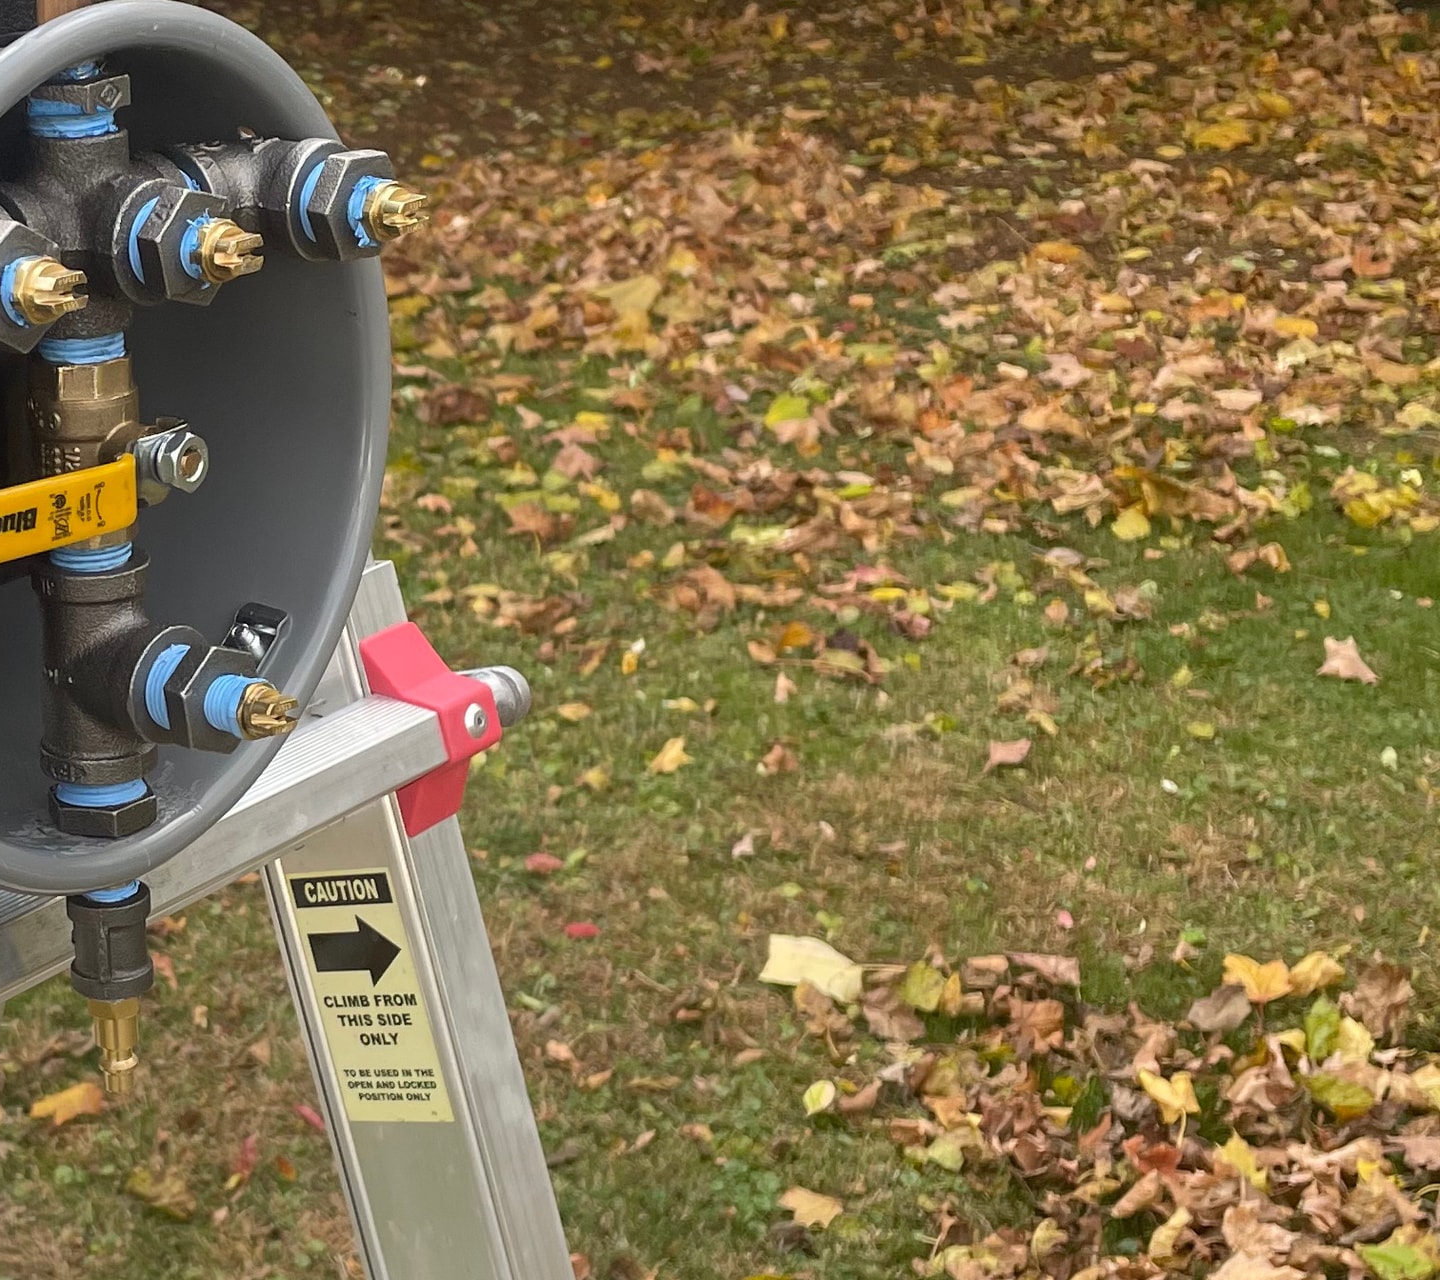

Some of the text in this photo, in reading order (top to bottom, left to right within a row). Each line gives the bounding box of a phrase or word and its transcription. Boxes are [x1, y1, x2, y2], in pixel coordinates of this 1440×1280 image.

[305, 879, 379, 902] CAUTION
[324, 994, 417, 1008] CLIMB FROM
[338, 1013, 412, 1027] THIS SIDE
[360, 1033, 399, 1046] ONLY
[344, 1069, 435, 1077] TO BE USED IN THE
[348, 1081, 437, 1089] OPEN AND LOCKED
